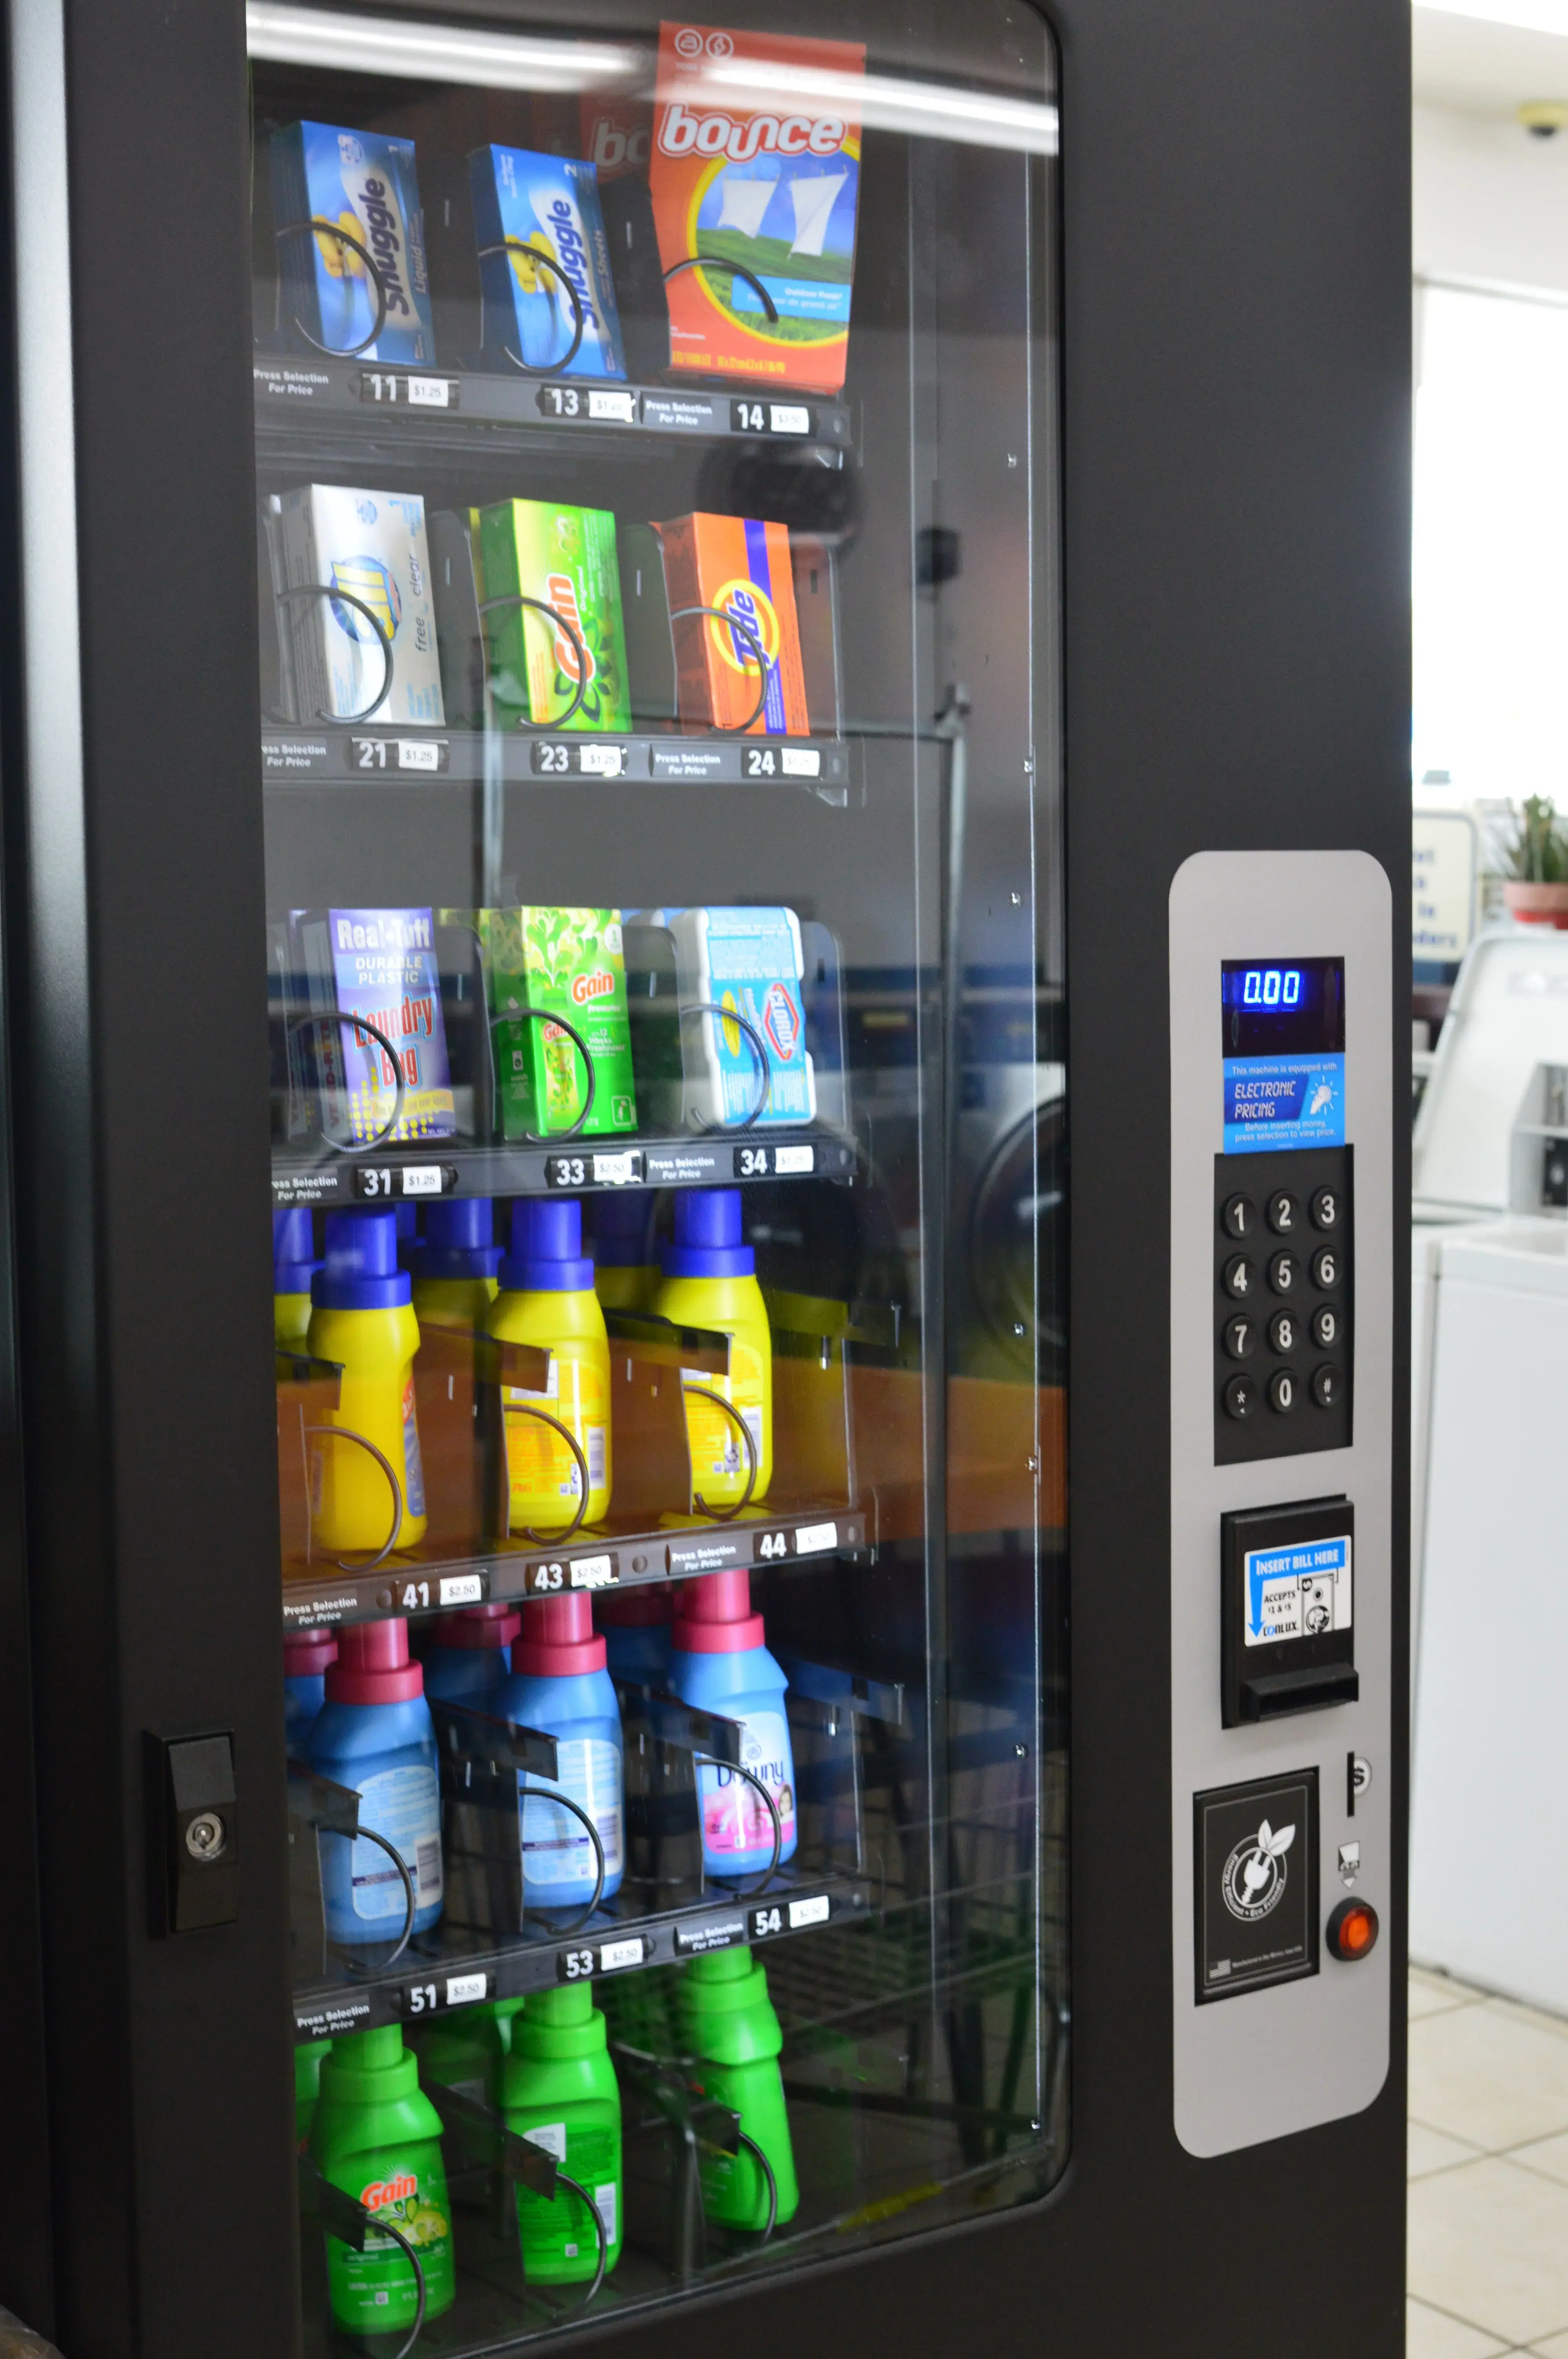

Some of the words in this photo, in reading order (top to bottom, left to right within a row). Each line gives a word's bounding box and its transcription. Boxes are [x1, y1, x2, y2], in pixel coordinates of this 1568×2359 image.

[660, 102, 847, 161] bounce
[358, 177, 410, 316] Snuggle
[410, 244, 426, 294] Liquid
[546, 200, 599, 329] Snuggle
[268, 383, 286, 393] For
[287, 384, 313, 395] Price
[283, 371, 329, 384] Selection
[370, 374, 397, 402] 11
[414, 385, 442, 398] $1.25
[551, 388, 579, 416] 13
[645, 400, 671, 412] Press
[672, 402, 713, 415] Selection
[659, 413, 675, 423] For
[675, 414, 699, 426] Price
[737, 403, 764, 431] 14
[409, 553, 423, 598] clear
[415, 616, 428, 653] free
[548, 574, 595, 683] Gain
[261, 745, 279, 755] ess
[281, 744, 327, 755] Selection
[267, 756, 284, 767] For
[285, 756, 311, 767] Price
[359, 742, 386, 768] 21
[405, 749, 432, 762] $1.25
[541, 745, 569, 772] 23
[655, 753, 679, 763] Press
[681, 754, 721, 764] Selection
[748, 749, 775, 776] 24
[668, 765, 683, 774] For
[684, 766, 707, 775] Price
[356, 956, 423, 970] DURABLE
[358, 971, 419, 985] PLASTIC
[572, 970, 614, 1003] Gain
[1243, 970, 1300, 1004] 0.00
[352, 995, 433, 1049] Laundry
[768, 990, 796, 1052] CLOROX
[380, 1047, 419, 1088] Bg
[1232, 1066, 1247, 1076] This
[1249, 1066, 1279, 1075] machine
[1288, 1063, 1321, 1074] equipped
[1322, 1062, 1338, 1071] with
[1235, 1081, 1297, 1099] ELECTRONIC
[1235, 1102, 1275, 1120] PRICING
[1235, 1134, 1255, 1144] press
[1256, 1131, 1289, 1141] selection
[1290, 1130, 1298, 1138] to
[1299, 1130, 1315, 1138] view
[1245, 1122, 1269, 1132] Before
[1270, 1120, 1301, 1131] inserting
[556, 1159, 584, 1185] 33
[649, 1160, 674, 1169] Press
[675, 1157, 715, 1168] Selection
[662, 1170, 677, 1180] For
[679, 1169, 701, 1179] Price
[740, 1149, 767, 1175] 34
[272, 1180, 290, 1189] ess
[292, 1176, 338, 1189] Selection
[364, 1169, 391, 1196] 31
[408, 1174, 436, 1187] $1.25
[278, 1190, 295, 1201] For
[296, 1189, 322, 1199] Price
[1234, 1203, 1245, 1232] 1
[1279, 1199, 1292, 1227] 2
[1321, 1195, 1335, 1224] 3
[1233, 1263, 1247, 1292] 4
[1278, 1259, 1291, 1288] 5
[1321, 1254, 1335, 1283] 6
[1234, 1324, 1247, 1354] 7
[1279, 1319, 1292, 1349] 8
[1321, 1313, 1335, 1342] 9
[1279, 1378, 1292, 1407] 0
[671, 1551, 695, 1563] Press
[696, 1545, 736, 1559] Selection
[760, 1532, 786, 1559] 44
[685, 1561, 701, 1571] For
[702, 1558, 723, 1569] Price
[1256, 1556, 1291, 1576] INSERT
[1293, 1553, 1313, 1569] BILL
[1314, 1548, 1339, 1566] HERE
[448, 1584, 475, 1597] $2.50
[535, 1564, 563, 1590] 43
[284, 1604, 311, 1617] Press
[312, 1597, 358, 1612] Selection
[403, 1581, 429, 1609] 41
[1264, 1590, 1296, 1603] ACCEPTS
[298, 1615, 314, 1625] For
[317, 1611, 342, 1622] Price
[717, 1760, 785, 1787] Downy
[1224, 1854, 1239, 1885] Energy
[1225, 1885, 1245, 1916] Efficient
[1263, 1877, 1284, 1910] Friendly
[755, 1908, 782, 1936] 54
[1250, 1907, 1263, 1918] Eco
[679, 1930, 704, 1944] Press
[705, 1923, 744, 1938] Selection
[692, 1941, 708, 1952] For
[708, 1936, 731, 1948] Price
[566, 1950, 593, 1978] 53
[410, 1983, 437, 2013] 51
[297, 2014, 325, 2028] Press
[325, 2005, 370, 2022] Selection
[312, 2025, 329, 2036] For
[330, 2019, 354, 2032] Price
[361, 2175, 416, 2212] Gain
